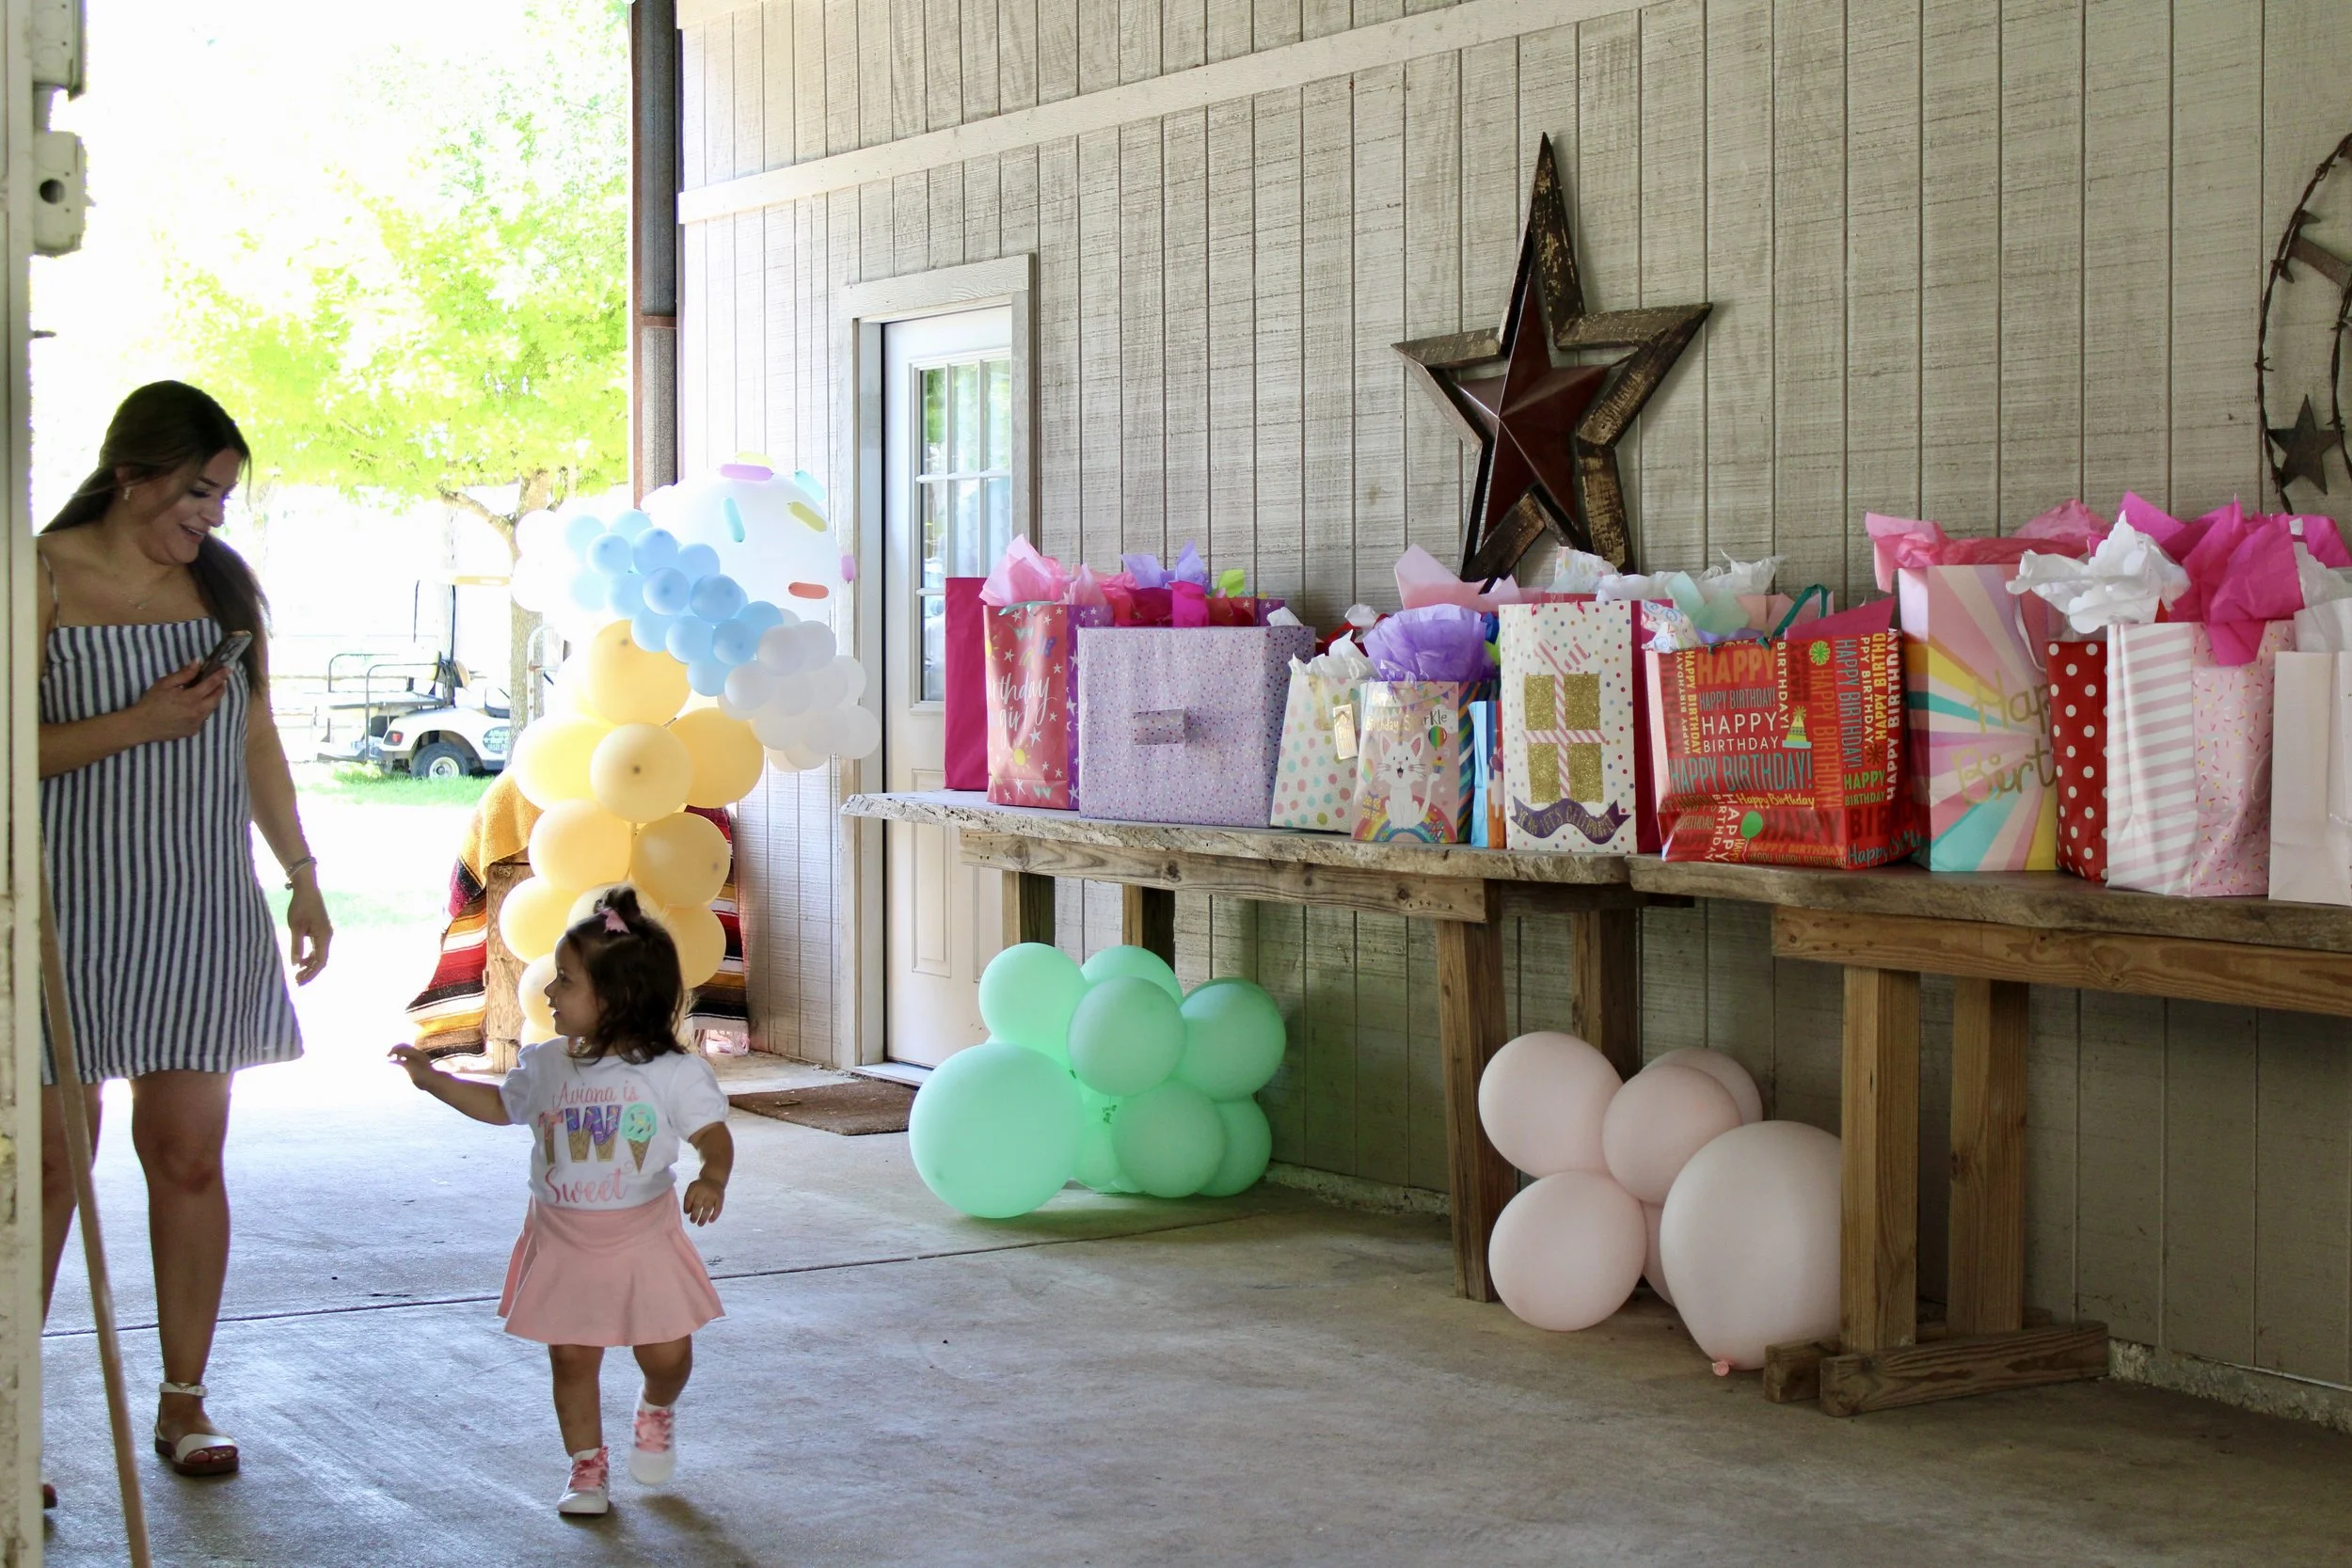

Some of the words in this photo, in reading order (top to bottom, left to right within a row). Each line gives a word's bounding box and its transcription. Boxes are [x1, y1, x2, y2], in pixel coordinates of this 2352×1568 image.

[1676, 651, 1687, 713] BIRTHDAY!
[1685, 650, 1696, 689] HAPPY
[1697, 646, 1776, 686] HAPPY
[1835, 639, 1860, 686] HAPPY
[1699, 689, 1727, 711] HAPPY
[1729, 687, 1776, 710] BIRTHDAY!
[1776, 641, 1789, 729] BIRTHDAY!
[1810, 669, 1837, 720] HAPPY
[999, 705, 1029, 749] girl
[1681, 718, 1691, 754] HAPPY
[1687, 693, 1702, 754] BIRTHDAY
[1701, 711, 1778, 736] HAPPY
[1838, 691, 1863, 768] BIRTHDAY!
[1874, 694, 1887, 740] HAPPY
[1703, 736, 1779, 753] BIRTHDAY
[1668, 755, 1721, 794] HAPPY
[1722, 751, 1814, 793] BIRTHDAY!
[1812, 725, 1843, 809] BIRTHDAY!
[1844, 770, 1886, 790] HAPPY
[1886, 737, 1899, 800] HAPPY
[1735, 792, 1771, 809] Happy
[1768, 793, 1815, 811] Birthday
[1844, 791, 1886, 806] BIRTHDAY
[1704, 794, 1728, 863] BIRTHDAY
[1713, 794, 1740, 863] HAPPY
[1847, 843, 1888, 867] Happy
[623, 1080, 641, 1102] is
[538, 1102, 658, 1174] TWO
[544, 1165, 631, 1204] Sweet
